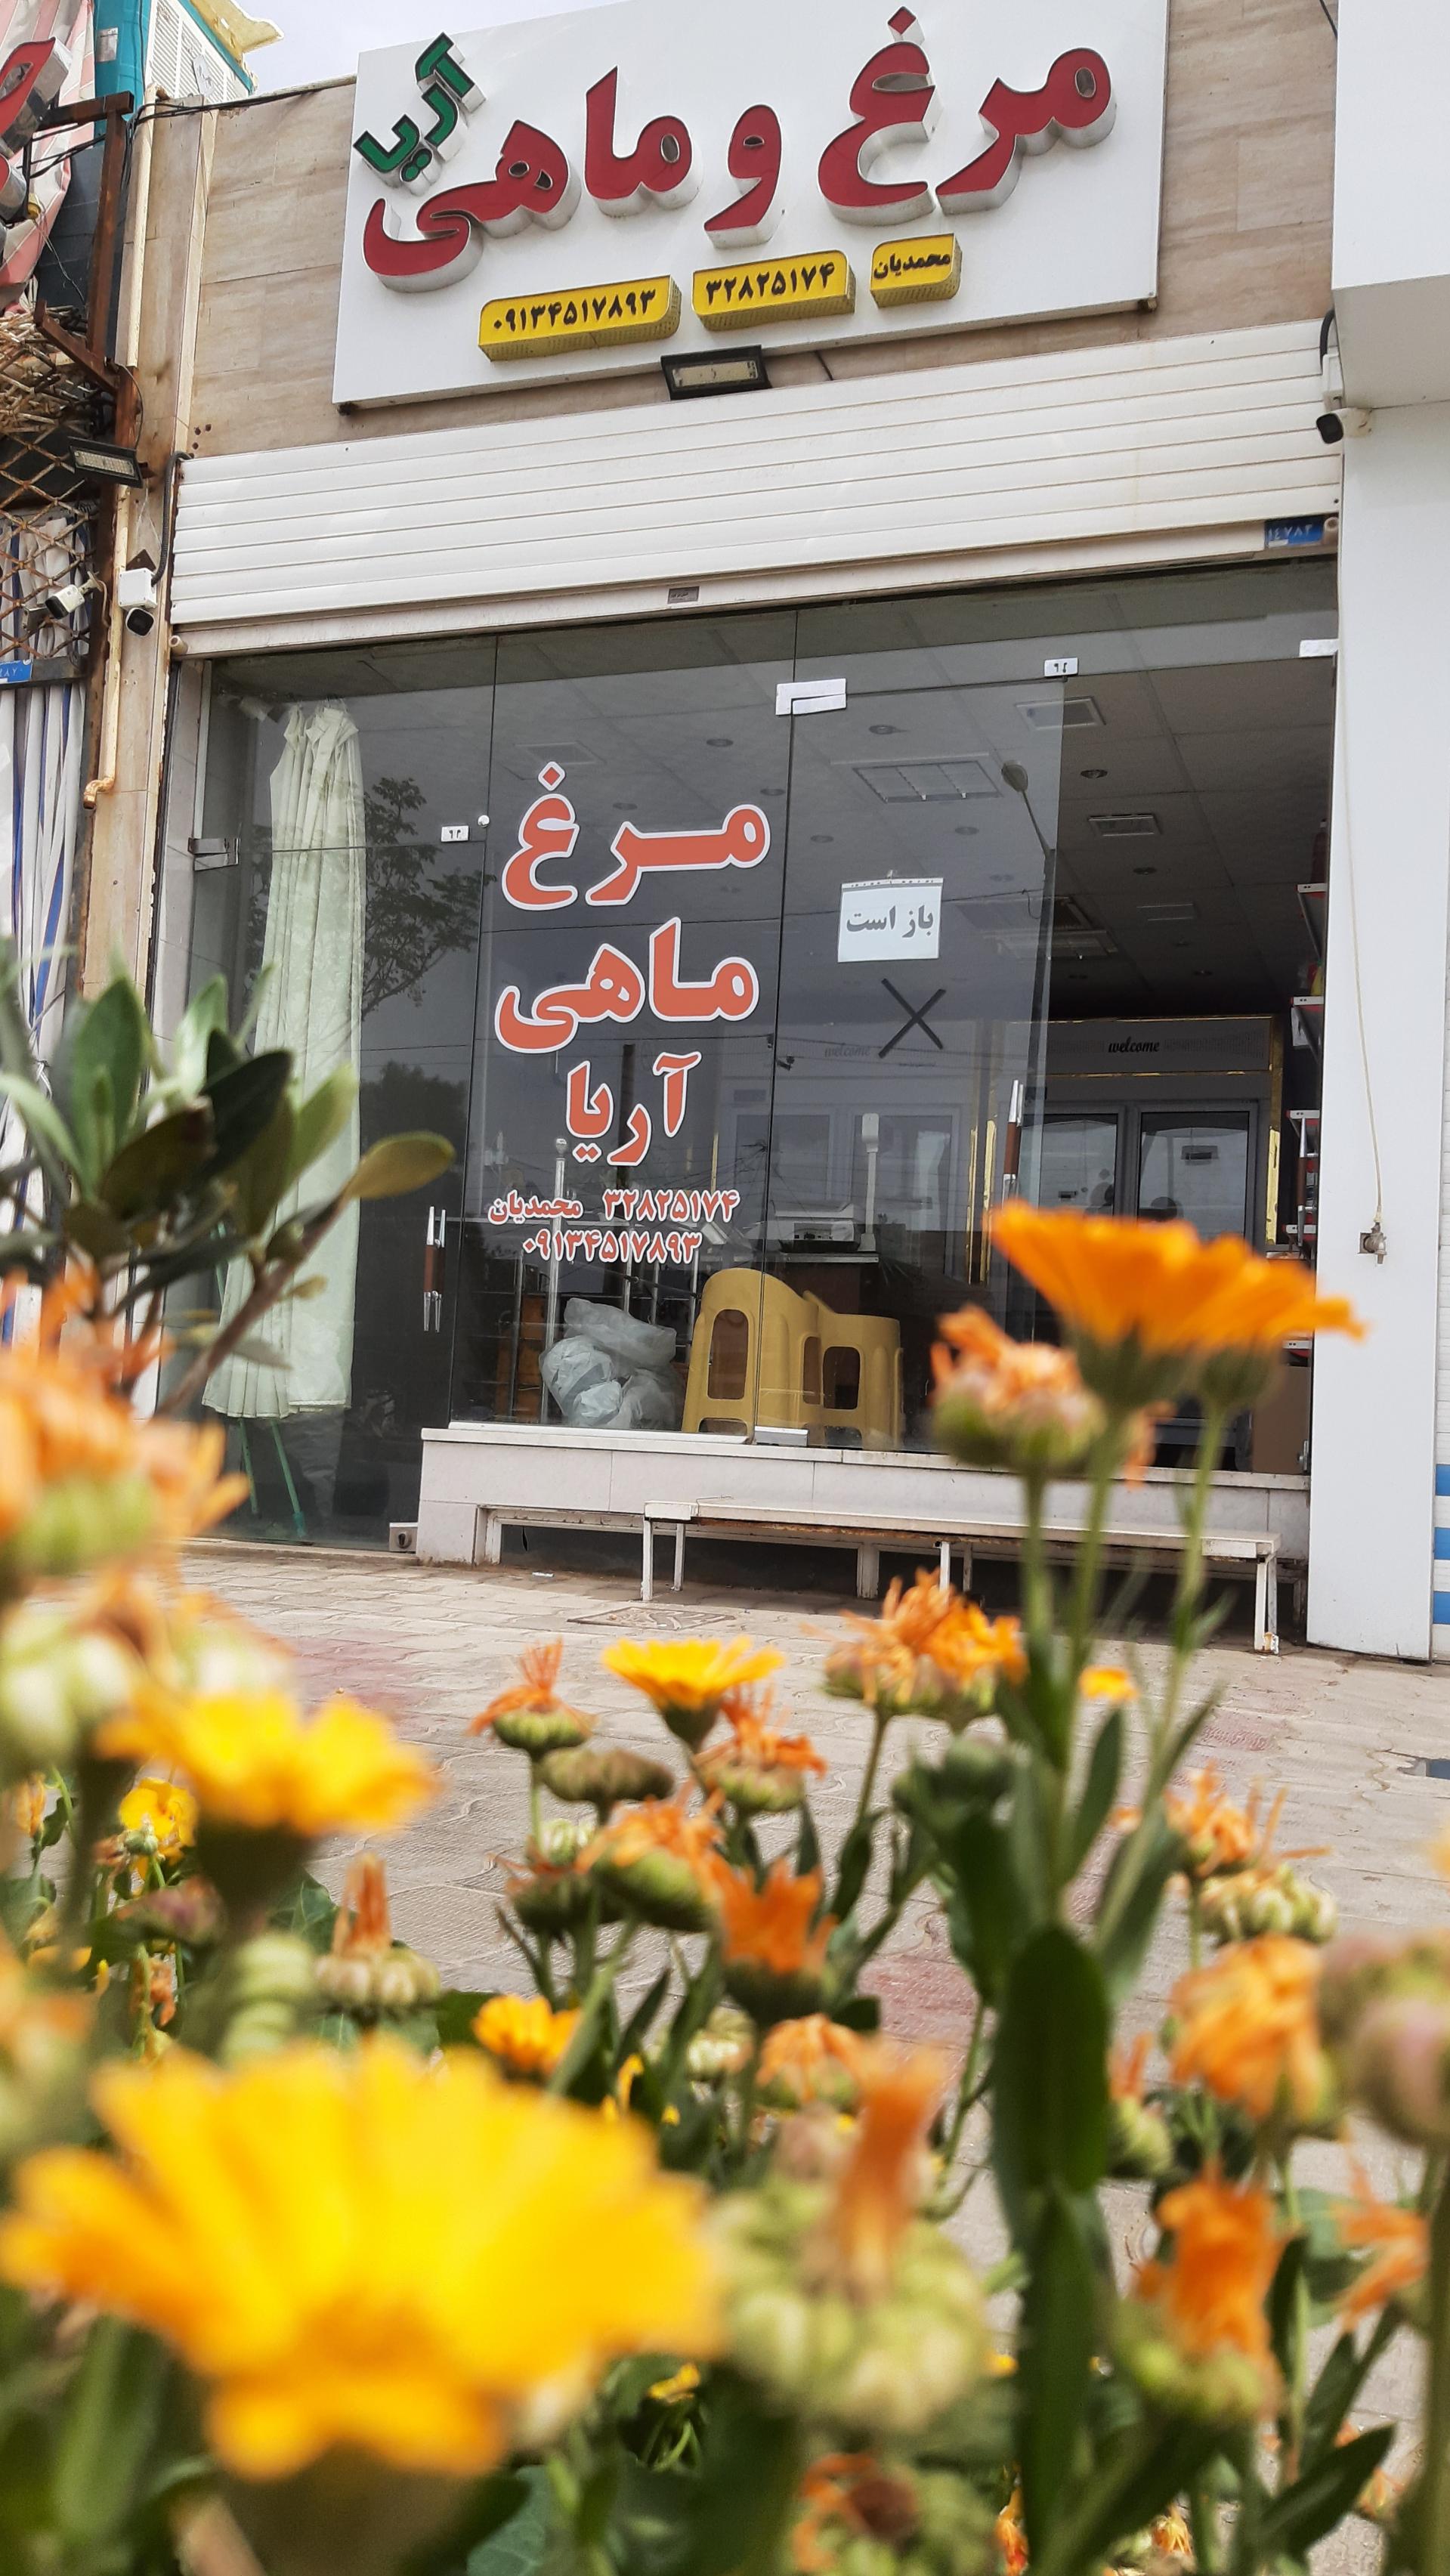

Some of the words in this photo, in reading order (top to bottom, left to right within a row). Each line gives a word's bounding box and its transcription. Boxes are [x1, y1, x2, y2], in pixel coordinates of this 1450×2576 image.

[358, 33, 470, 183] آریا
[818, 6, 1114, 209] مرغ
[363, 68, 694, 278] ماهی
[704, 104, 783, 233] و
[705, 262, 836, 305] ۳۲۸۲۵۱۷۴
[873, 252, 951, 280] محمدیان
[493, 289, 657, 332] ۰۹۱۳۴۵۱۷۸۹۳
[502, 762, 771, 911] مرغ
[846, 905, 897, 932] است
[902, 905, 935, 938] باز
[495, 917, 759, 1053] ماهی
[1108, 1036, 1161, 1054] welcome
[566, 1051, 703, 1166] آریا
[487, 1189, 584, 1225] محمدیان
[602, 1189, 740, 1223] ۳۲۸۲۵۱۷۴
[522, 1228, 703, 1264] ۰۹۱۳۴۵۱۷۸۹۳
